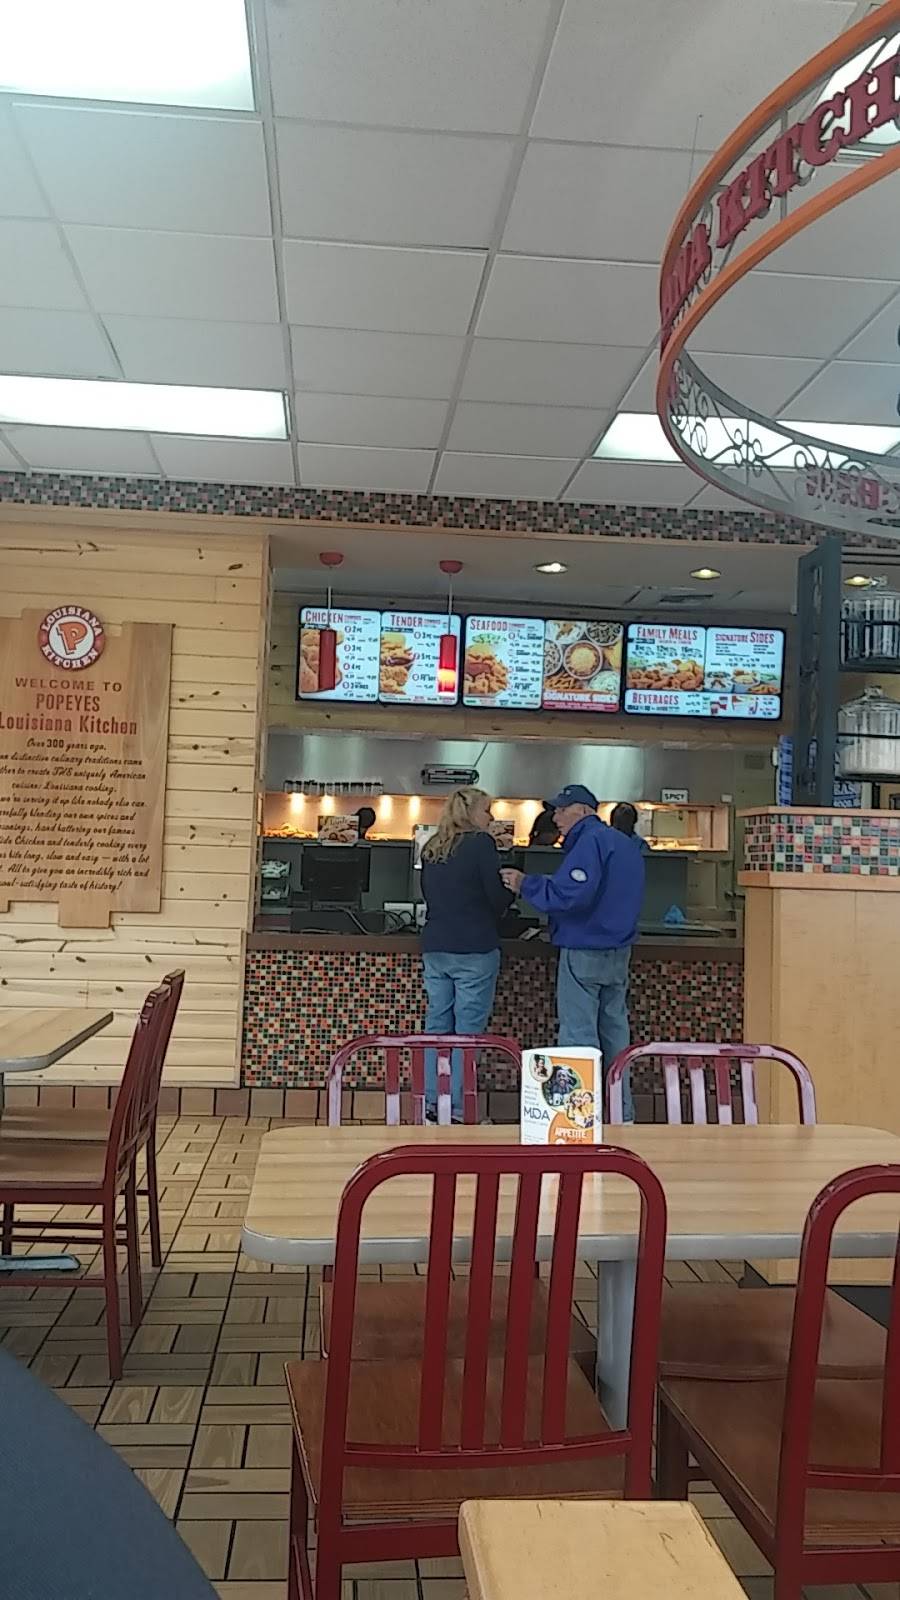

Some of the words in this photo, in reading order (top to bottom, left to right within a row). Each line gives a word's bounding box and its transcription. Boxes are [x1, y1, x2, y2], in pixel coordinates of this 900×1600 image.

[41, 606, 103, 636] LOUISIANA
[391, 615, 423, 628] TENDER
[470, 618, 508, 631] SEAFOOD
[637, 626, 667, 639] FAMILY
[669, 627, 698, 641] MEALS
[750, 631, 775, 644] SIDES
[41, 645, 99, 670] KITCHEN
[15, 677, 95, 691] WELCOME
[103, 681, 122, 692] TO
[35, 693, 101, 712] POPEYES
[632, 692, 679, 705] BEVERAGES
[0, 711, 72, 732] Louisiana
[79, 715, 138, 735] Kitchen
[26, 738, 45, 748] Over
[46, 739, 65, 749] 300
[65, 741, 88, 752] years
[89, 744, 107, 753] ago.
[10, 751, 49, 762] distinctive
[51, 754, 83, 766] culinary
[84, 756, 122, 765] traditions
[27, 768, 51, 776] create
[52, 766, 73, 777] THE
[73, 768, 107, 781] uniquely
[109, 769, 147, 780] American
[43, 781, 84, 791] Louisiana
[84, 783, 117, 796] cooking.
[23, 796, 50, 806] serving
[60, 798, 70, 807] up
[86, 797, 113, 810] nobody
[30, 808, 62, 821] blending
[120, 812, 136, 820] and
[35, 822, 56, 832] hand
[57, 823, 91, 836] battering
[107, 825, 136, 836] famous
[14, 835, 45, 846] Chicken
[47, 837, 62, 846] and
[63, 837, 94, 850] tenderly
[96, 839, 126, 852] cooking
[9, 850, 22, 860] bite
[46, 850, 63, 860] slow
[65, 852, 81, 861] and
[81, 854, 99, 864] easy
[7, 864, 21, 874] All
[22, 866, 30, 874] to
[31, 866, 48, 878] give
[49, 868, 63, 877] you
[77, 867, 115, 879] incredibly
[117, 868, 132, 877] rich
[134, 868, 150, 877] and
[59, 881, 78, 889] taste
[88, 881, 122, 893] history!
